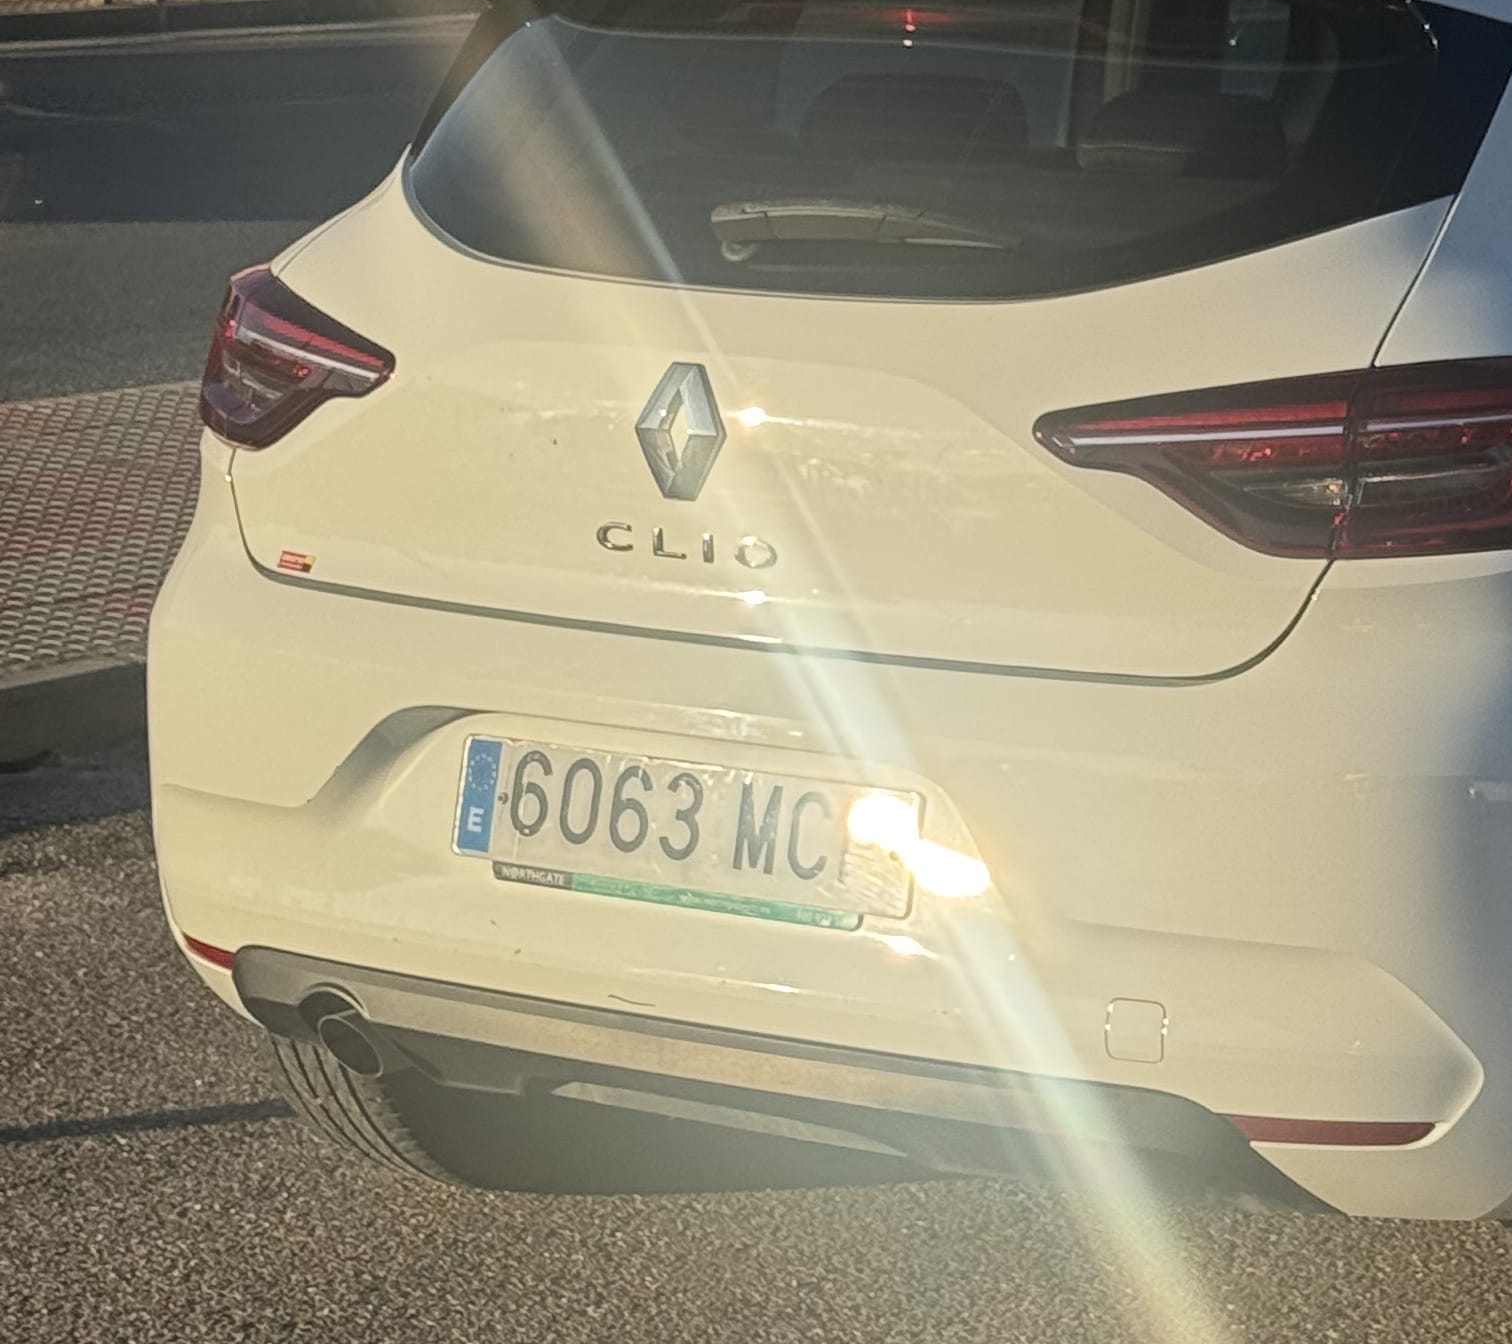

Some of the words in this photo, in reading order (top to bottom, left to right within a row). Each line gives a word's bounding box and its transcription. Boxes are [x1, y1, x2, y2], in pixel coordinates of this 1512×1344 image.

[596, 521, 778, 570] CLIO
[466, 805, 484, 834] E
[509, 749, 704, 862] 6063
[732, 780, 856, 882] MC
[501, 862, 566, 887] NORTHGATE
